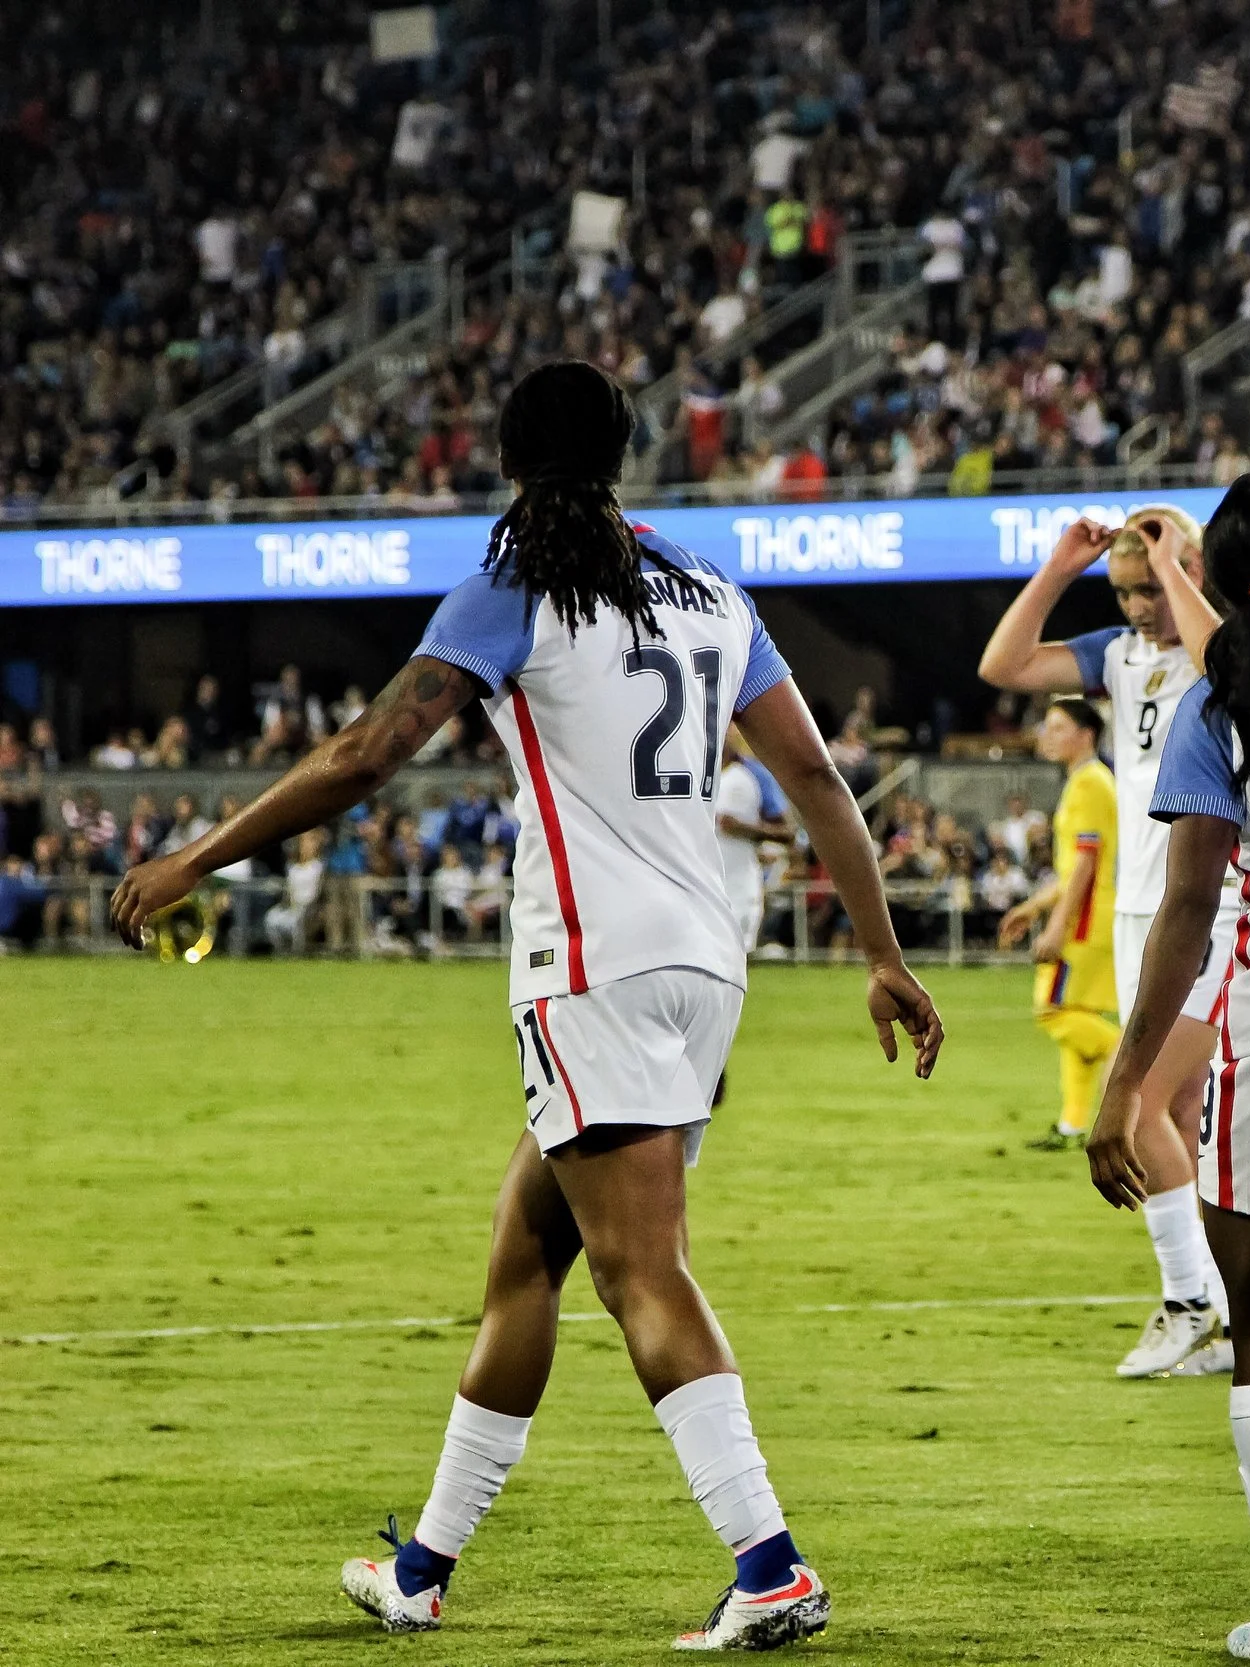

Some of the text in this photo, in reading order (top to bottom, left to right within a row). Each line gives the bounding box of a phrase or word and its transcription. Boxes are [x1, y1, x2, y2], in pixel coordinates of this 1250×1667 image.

[35, 537, 182, 594] THORNE
[256, 531, 411, 588] THORNE
[733, 511, 903, 573] THORNE
[622, 645, 722, 801] 21
